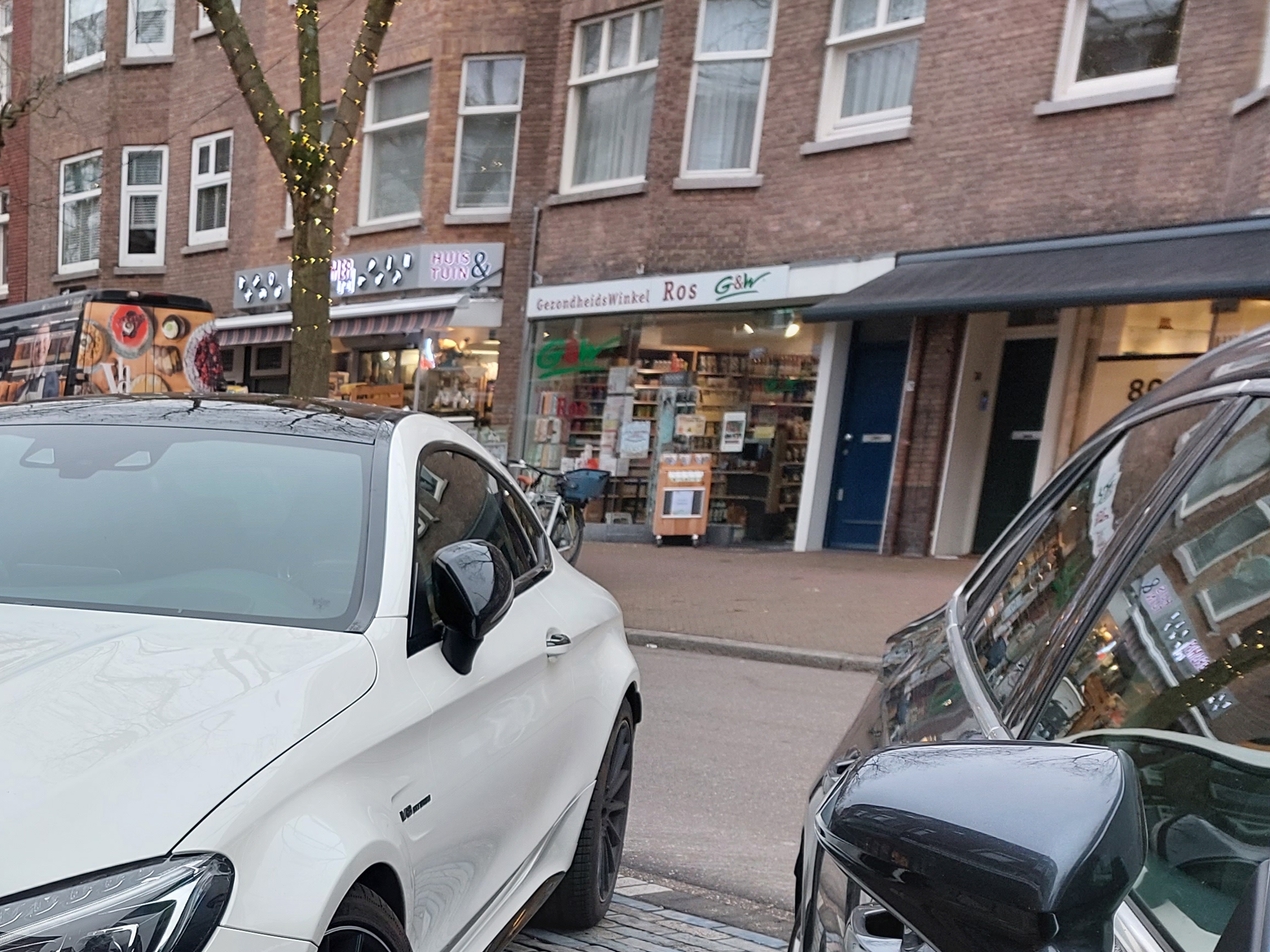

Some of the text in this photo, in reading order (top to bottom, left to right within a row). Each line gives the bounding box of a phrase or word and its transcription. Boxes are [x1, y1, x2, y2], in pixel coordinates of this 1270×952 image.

[431, 267, 469, 281] TUIN
[432, 251, 491, 278] HUIS &
[536, 271, 771, 311] GezondheidsWinkel Ros G&W
